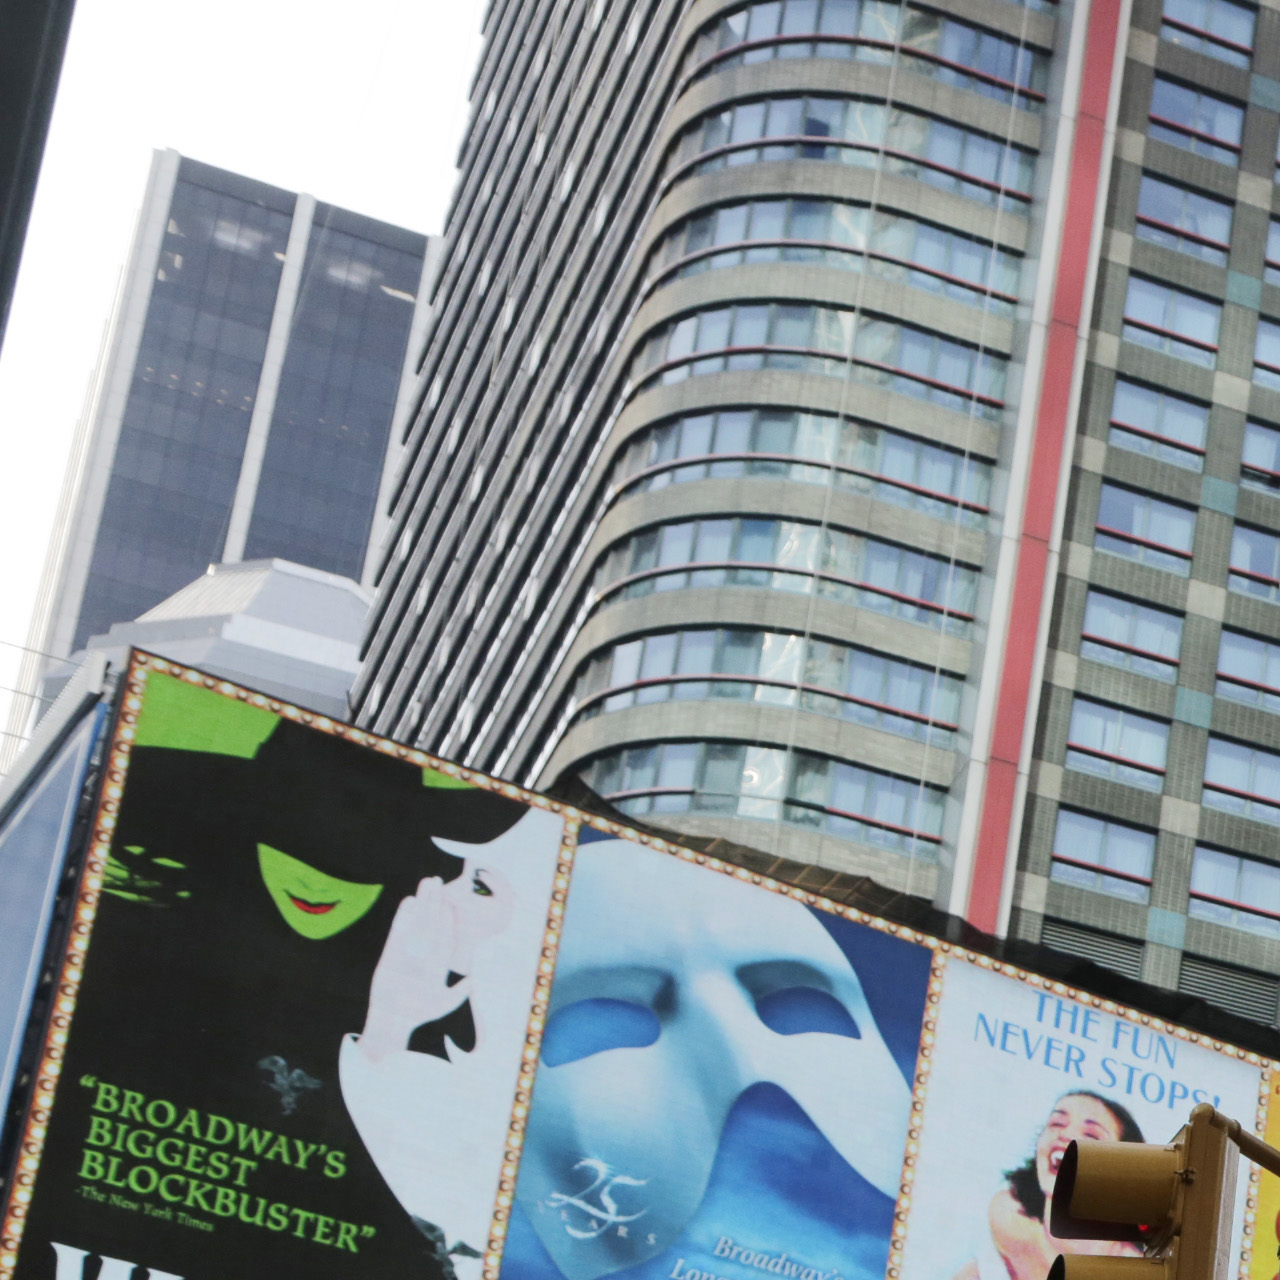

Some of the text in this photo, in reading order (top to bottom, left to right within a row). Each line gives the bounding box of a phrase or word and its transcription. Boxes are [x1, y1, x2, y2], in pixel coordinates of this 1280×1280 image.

[973, 1012, 1086, 1078] NEVER
[1032, 990, 1177, 1069] THE FUN
[86, 1115, 258, 1187] BIGGEST
[109, 1194, 139, 1212] New
[144, 1203, 173, 1221] York
[177, 1211, 215, 1232] Times
